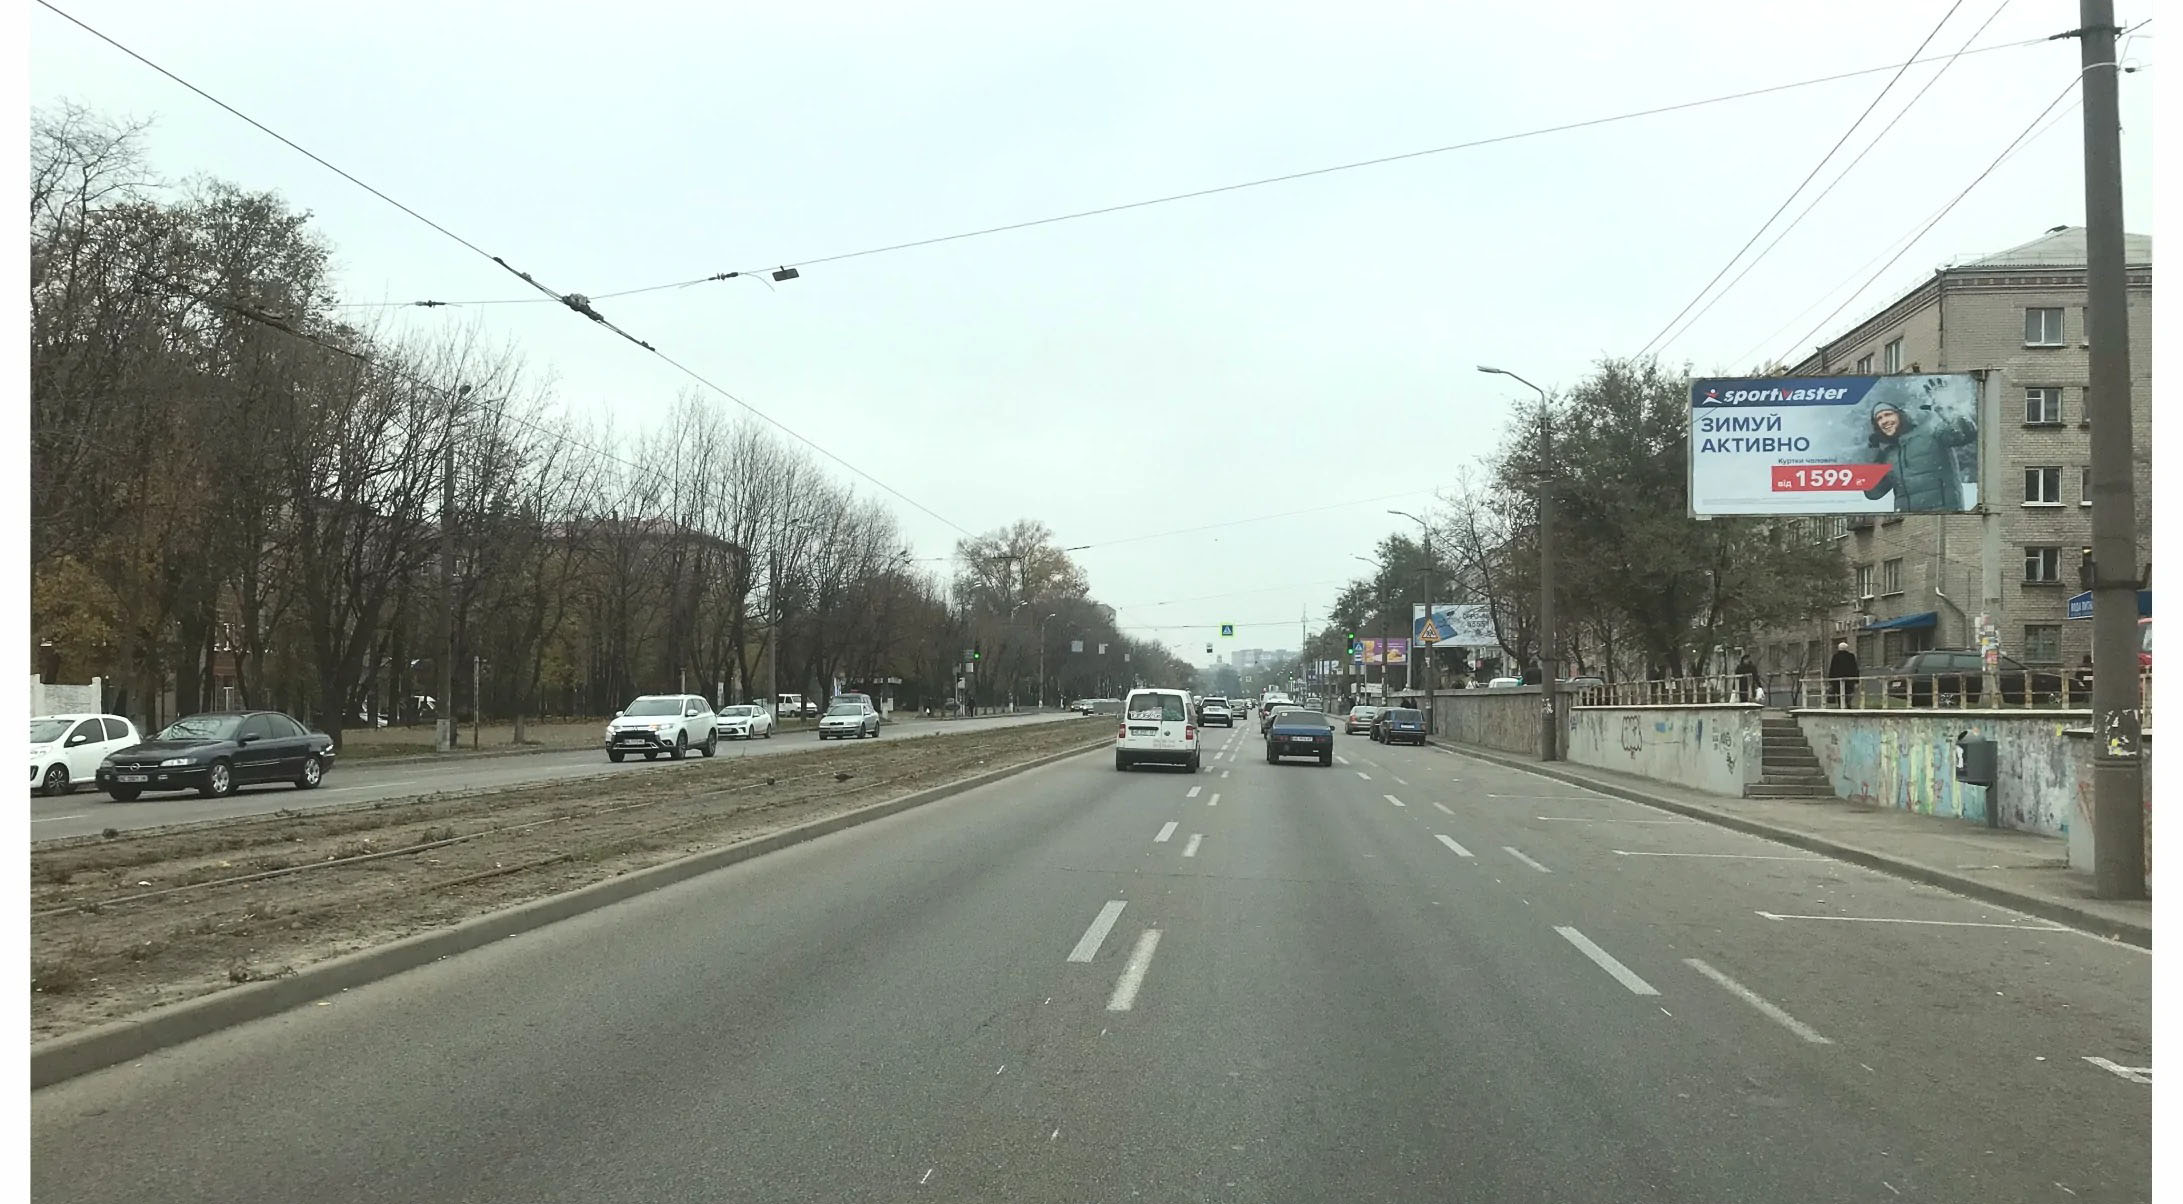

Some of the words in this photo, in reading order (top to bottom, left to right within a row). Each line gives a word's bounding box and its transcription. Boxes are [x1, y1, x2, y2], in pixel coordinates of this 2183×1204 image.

[1701, 413, 1782, 432] ЗИМУЙ
[1700, 437, 1810, 453] АКТИВНО
[1778, 480, 1792, 488] від
